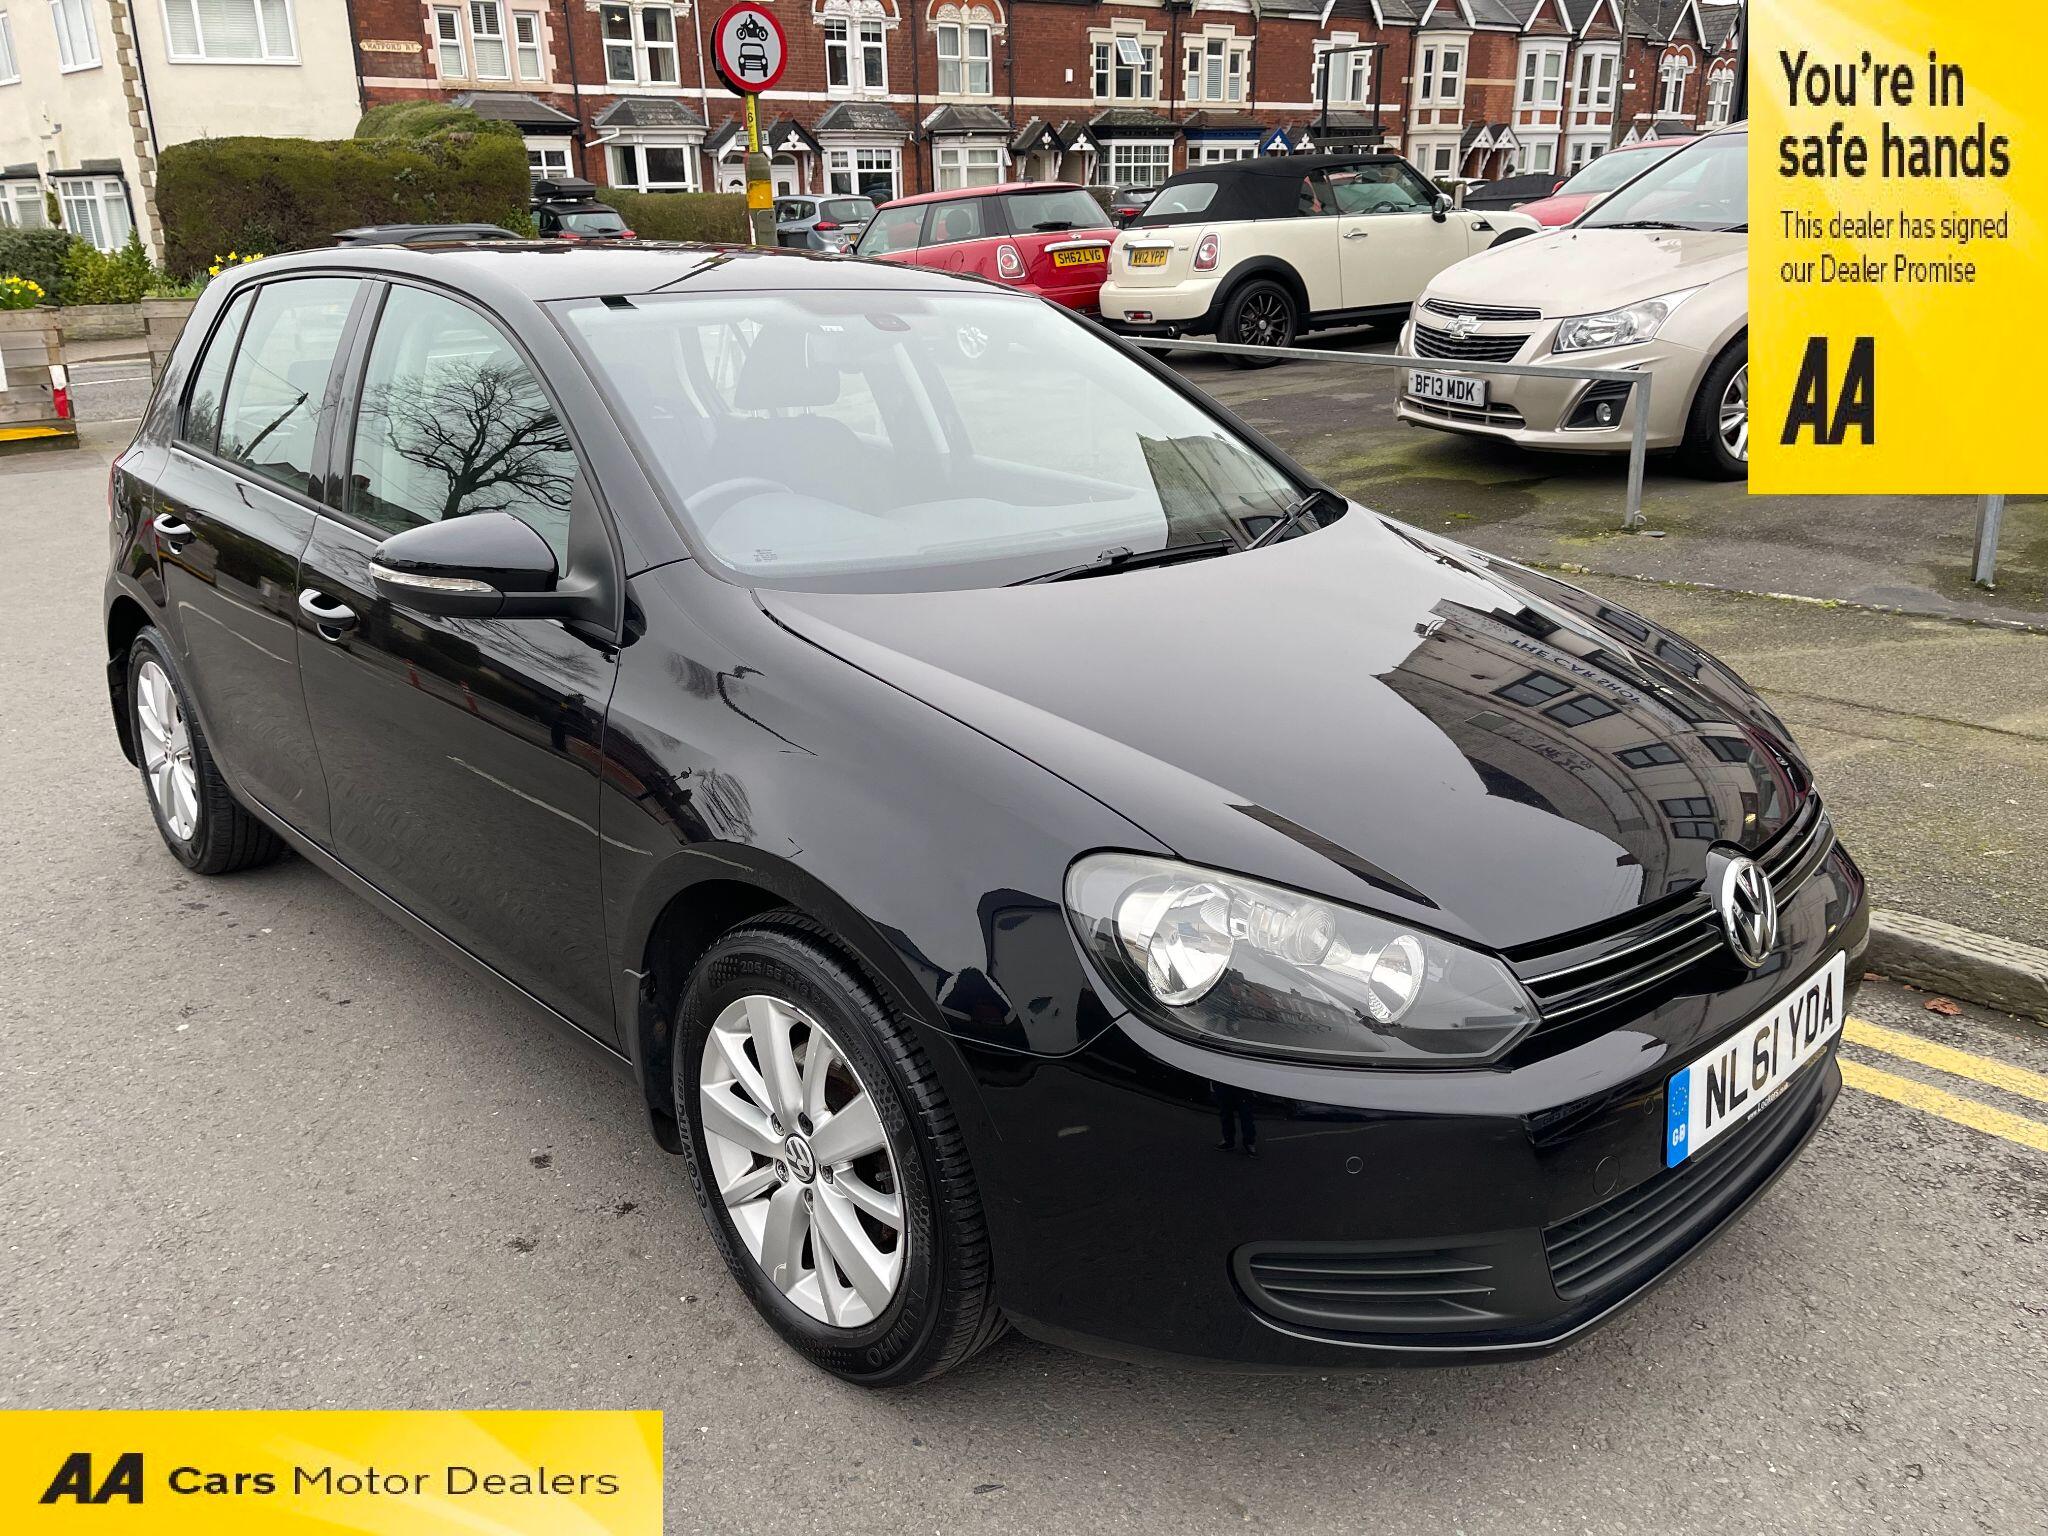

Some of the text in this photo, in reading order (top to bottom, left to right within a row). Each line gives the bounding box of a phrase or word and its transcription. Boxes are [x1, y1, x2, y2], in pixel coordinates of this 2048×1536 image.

[1059, 248, 1101, 265] SH62 LVG
[1150, 250, 1165, 263] YPP
[1415, 374, 1476, 401] BF13 MDK
[1706, 972, 1834, 1129] NL61 YDA
[1672, 1123, 1686, 1147] GB
